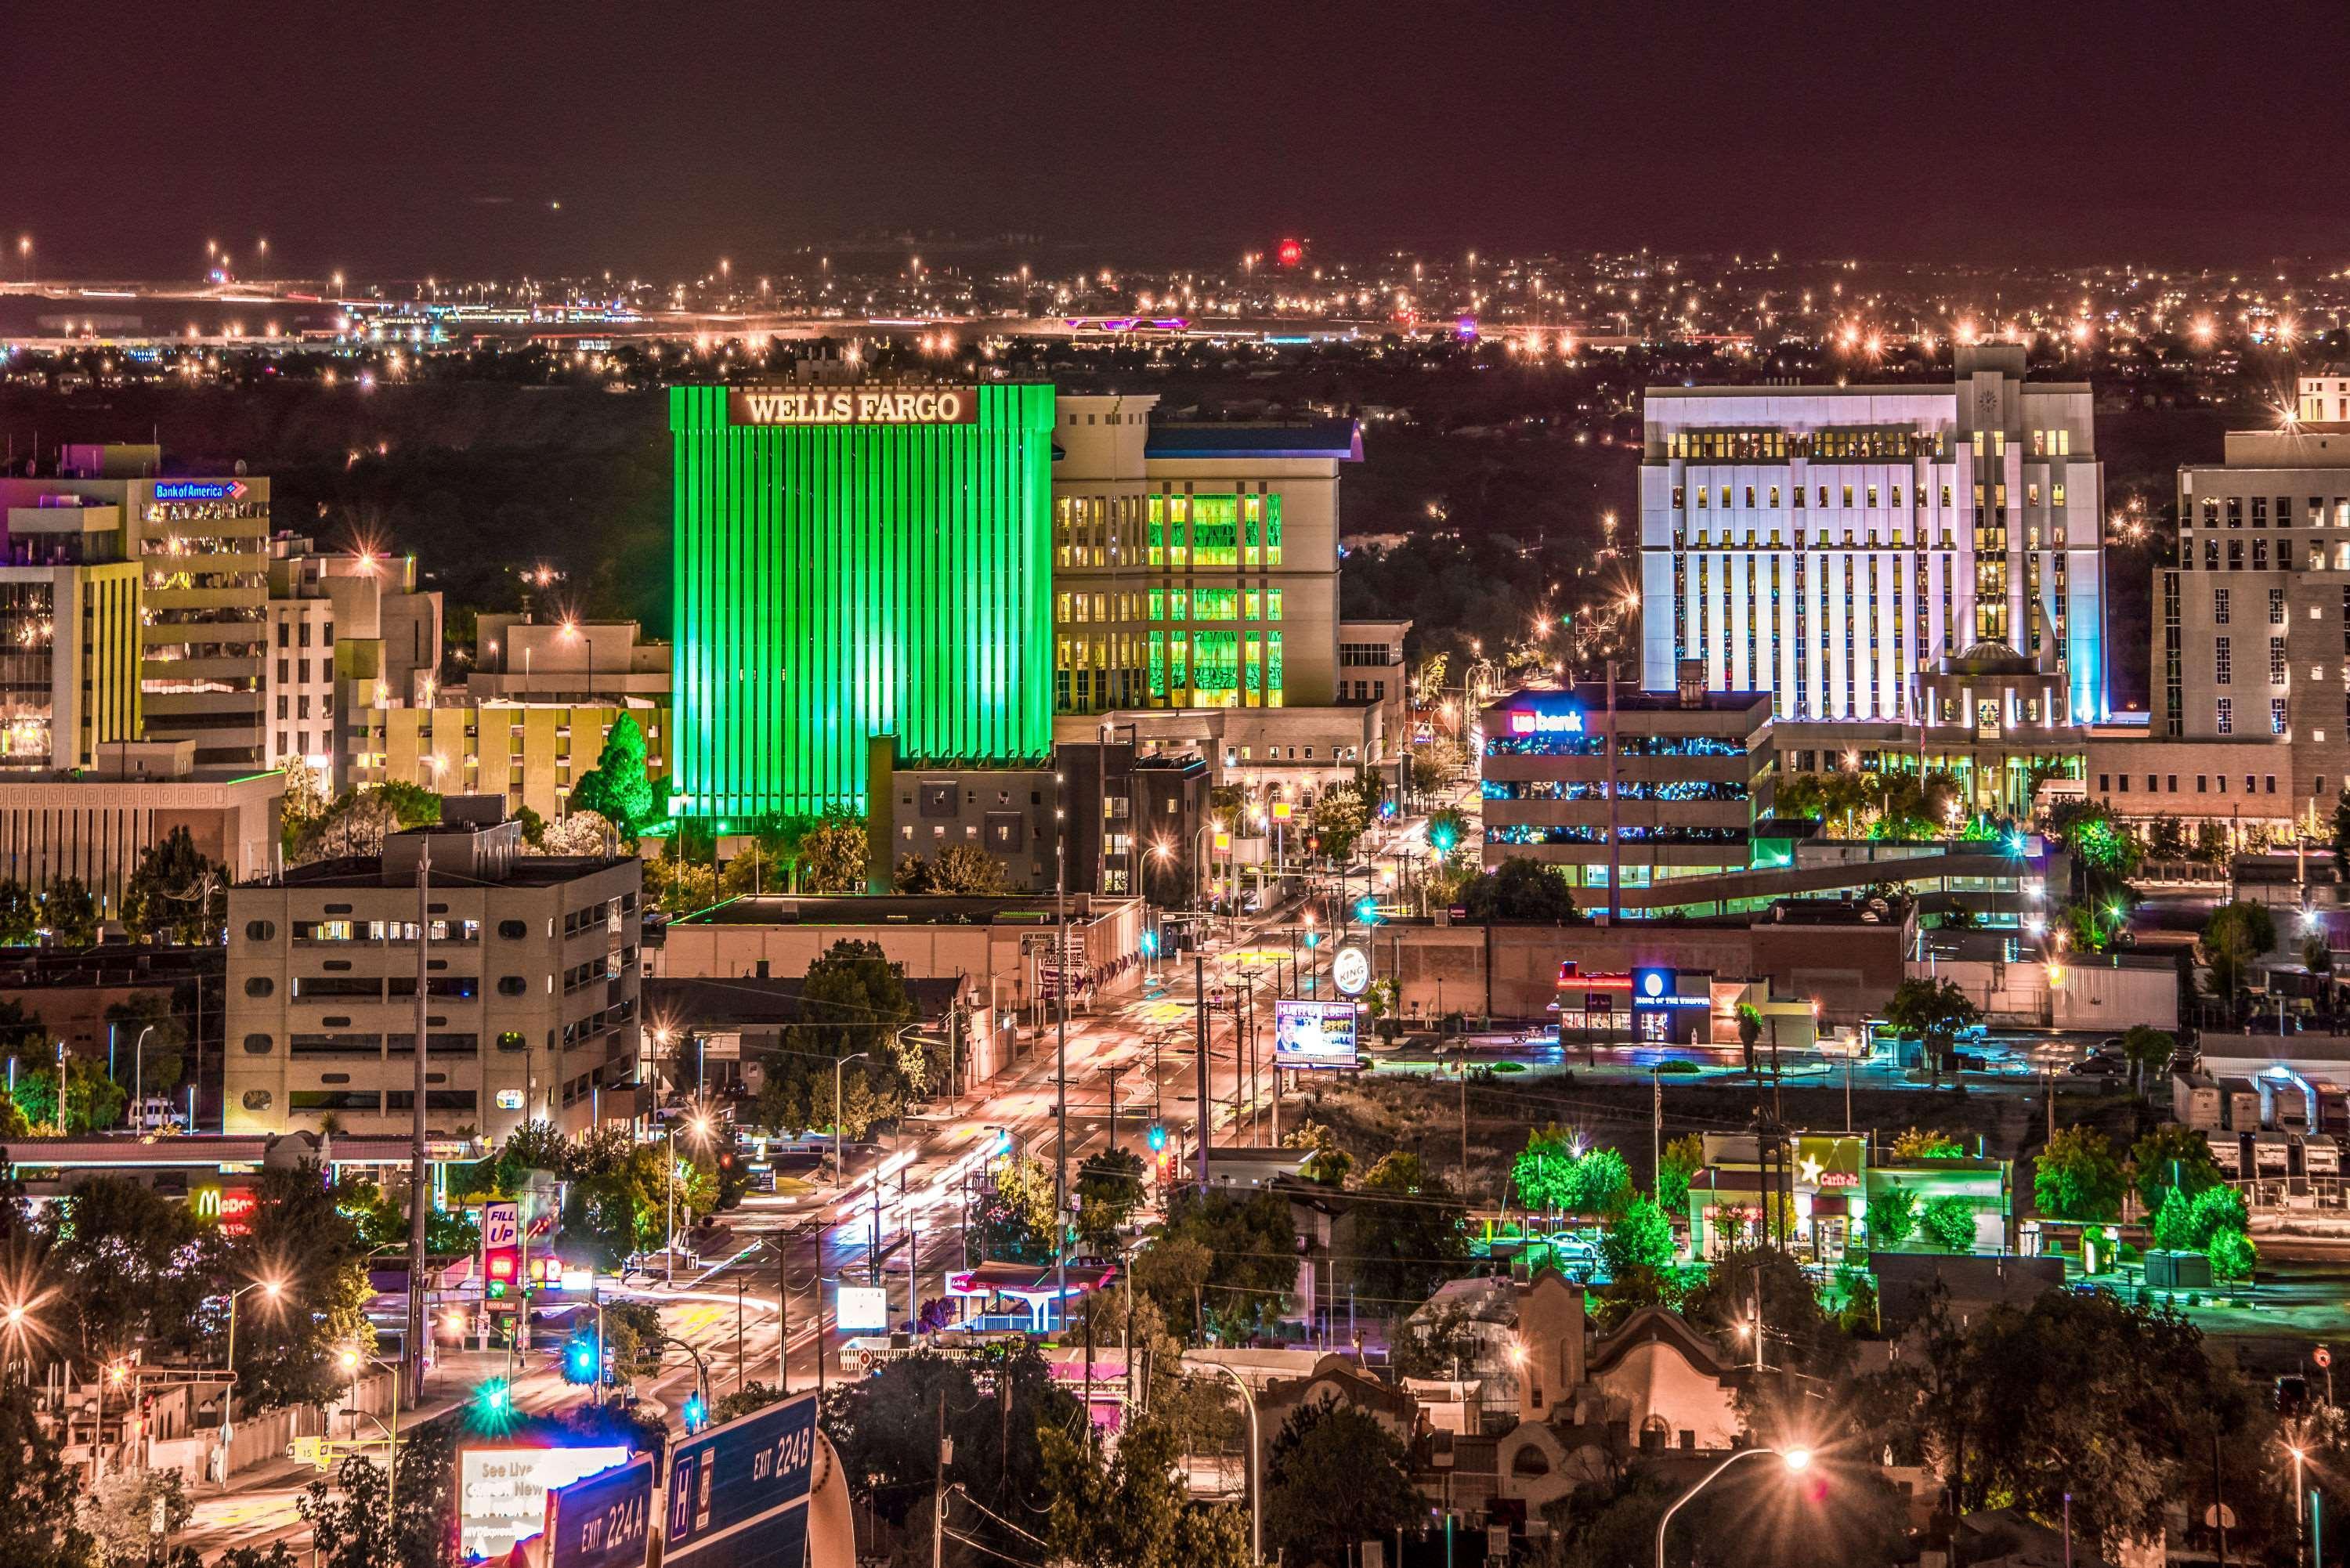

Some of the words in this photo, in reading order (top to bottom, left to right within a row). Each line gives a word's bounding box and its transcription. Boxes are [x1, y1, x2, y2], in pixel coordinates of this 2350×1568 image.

[746, 394, 852, 421] WELLS
[858, 393, 960, 421] FARGO
[157, 485, 178, 497] Bank
[179, 485, 187, 497] of
[188, 484, 222, 497] America
[1535, 710, 1582, 732] bank
[1340, 966, 1364, 982] KING
[1820, 1173, 1846, 1186] Carl's
[1846, 1173, 1860, 1187] Jr.
[490, 1211, 515, 1221] FILL
[490, 1223, 514, 1242] UP
[754, 1448, 772, 1481] EXIT
[776, 1427, 810, 1479] 224B
[482, 1461, 506, 1478] See
[510, 1461, 534, 1477] Live
[515, 1481, 543, 1497] New
[581, 1518, 602, 1553] EXIT
[606, 1494, 643, 1550] 224A
